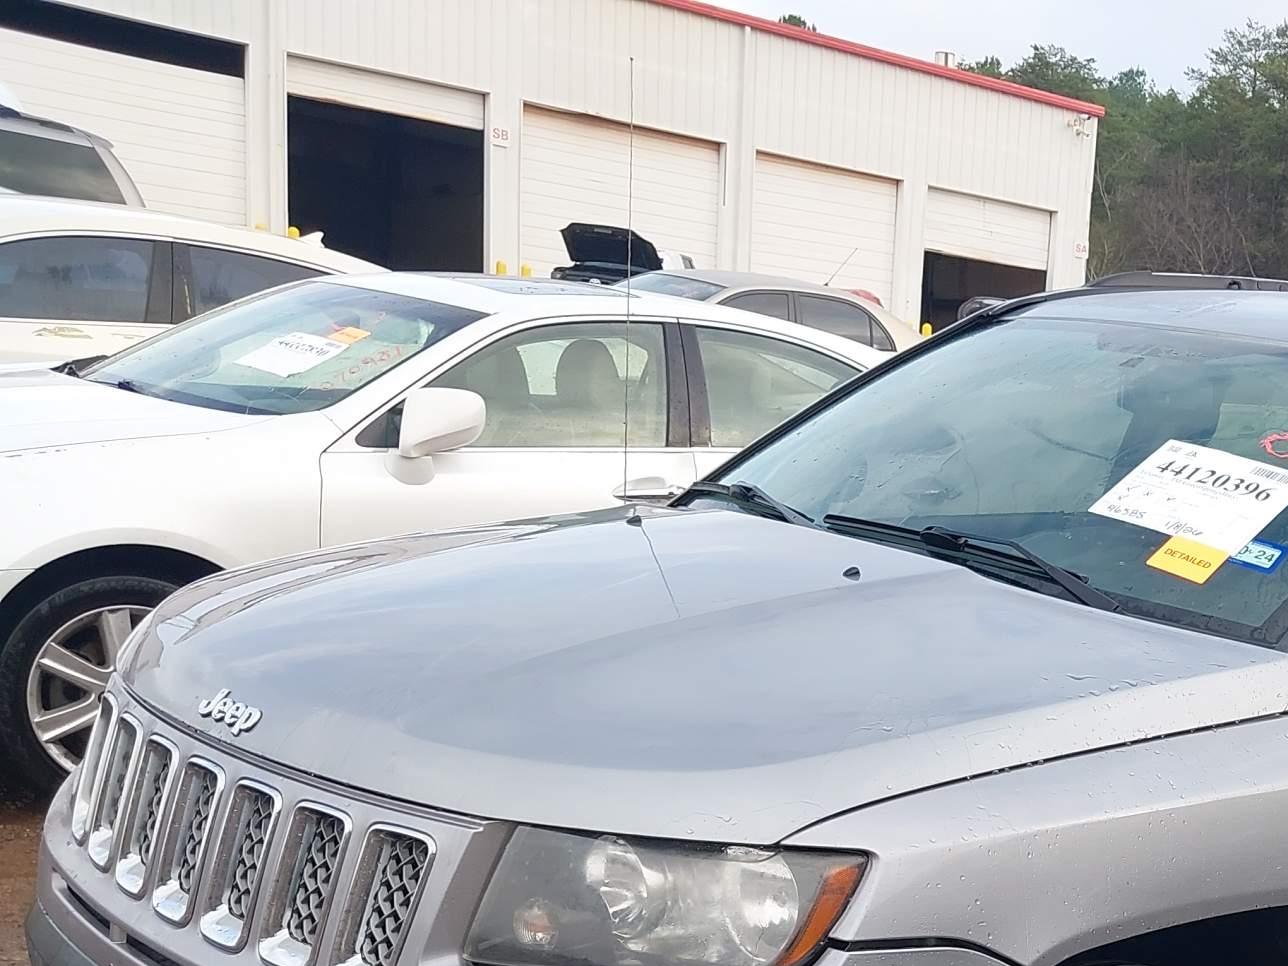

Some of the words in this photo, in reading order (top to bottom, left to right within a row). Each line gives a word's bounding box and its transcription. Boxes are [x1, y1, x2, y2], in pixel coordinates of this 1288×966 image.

[1157, 460, 1272, 502] 44120396
[1163, 547, 1213, 569] DETAILED
[1253, 550, 1275, 562] 24
[199, 688, 263, 737] Jeep
